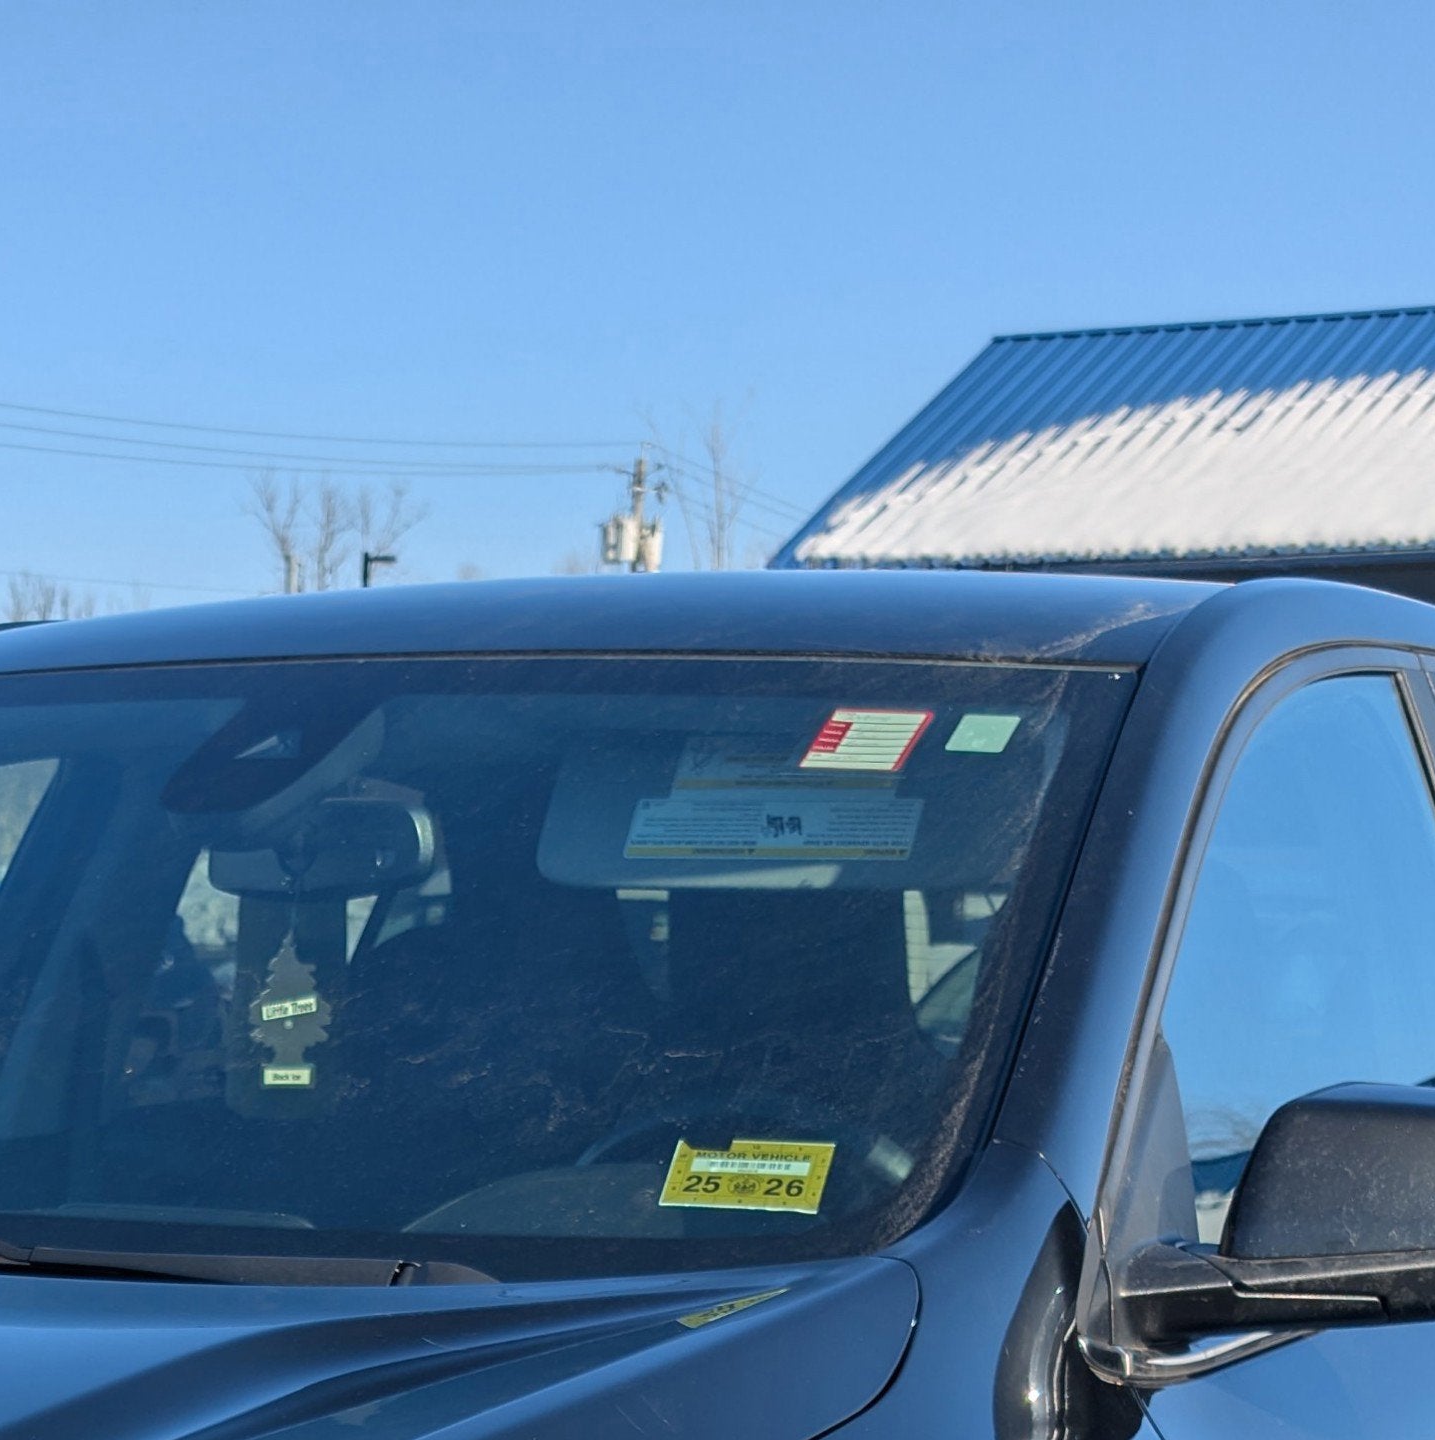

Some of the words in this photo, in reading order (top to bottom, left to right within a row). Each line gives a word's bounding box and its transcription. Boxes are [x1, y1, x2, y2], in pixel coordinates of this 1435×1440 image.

[695, 1151, 747, 1160] MOTOR
[751, 1152, 812, 1162] VEHICLE
[682, 1175, 722, 1193] 25
[763, 1178, 805, 1197] 26
